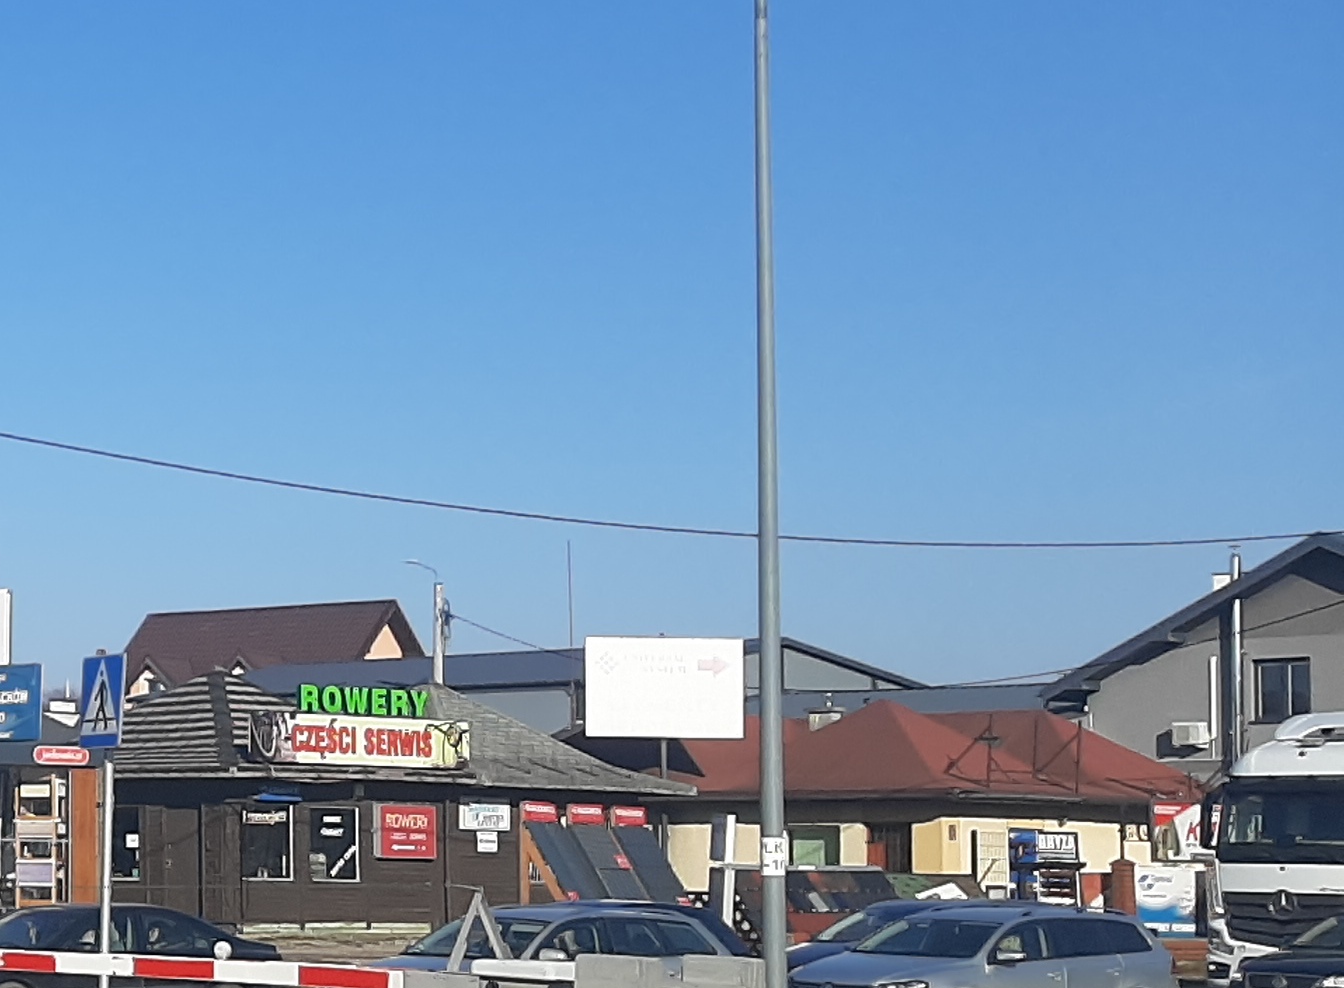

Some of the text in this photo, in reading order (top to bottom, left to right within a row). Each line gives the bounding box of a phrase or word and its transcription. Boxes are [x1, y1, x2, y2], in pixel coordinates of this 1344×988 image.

[300, 684, 431, 716] ROWERY
[291, 719, 433, 759] CZĘŚCI SERWIS
